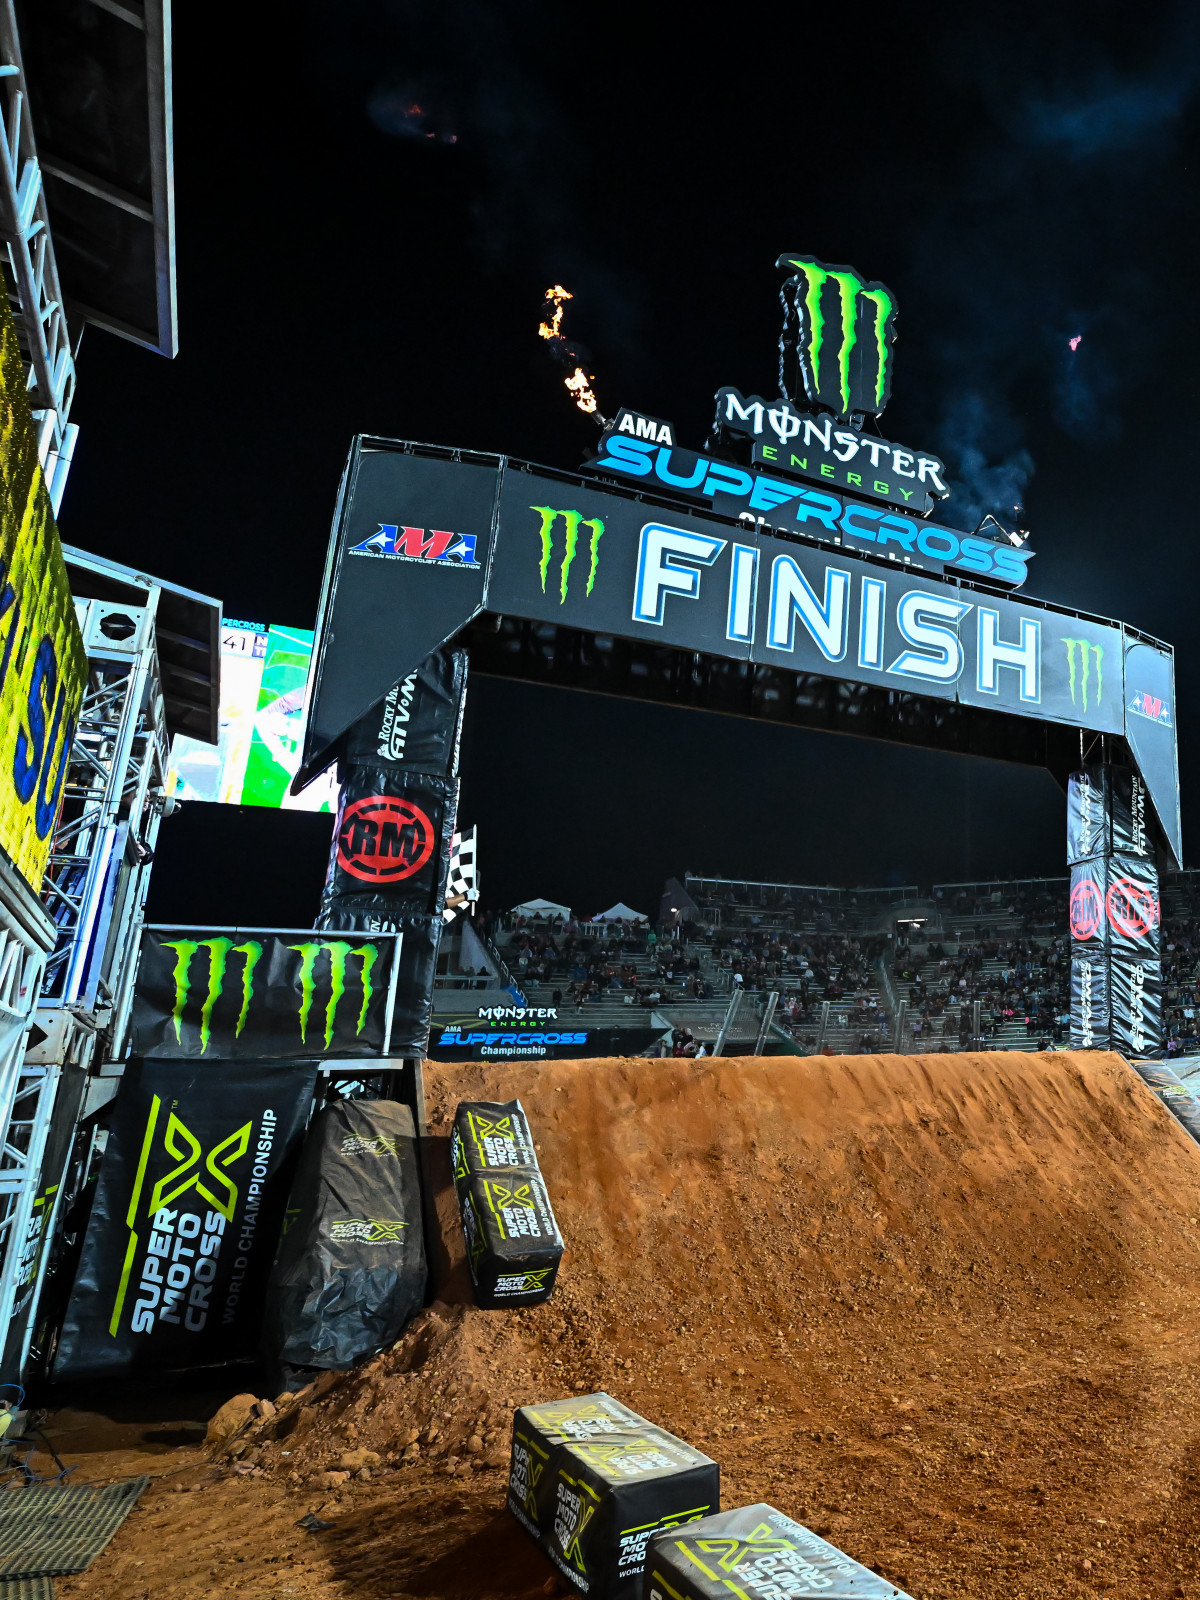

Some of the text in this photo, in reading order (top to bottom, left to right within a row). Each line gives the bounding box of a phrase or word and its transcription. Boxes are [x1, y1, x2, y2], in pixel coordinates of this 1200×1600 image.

[618, 413, 673, 446] AMA
[726, 393, 946, 490] MONSTER
[762, 446, 914, 500] ENERGY
[597, 435, 1036, 583] SUPERCROSS
[347, 523, 482, 565] AMA
[349, 550, 480, 570] AMERICAN MOTORCYCLIST ASSOCIATION
[222, 618, 265, 632] PERCROSS
[632, 522, 1041, 704] FINISH
[223, 635, 246, 651] 41
[350, 818, 417, 859] RM
[478, 1005, 558, 1020] MONSTER
[438, 1032, 588, 1045] SUPERCROSS
[481, 1046, 546, 1056] Championship
[221, 1108, 278, 1325] WORLD CHAMPIONSHIP
[502, 1207, 520, 1238] SUPER
[512, 1208, 531, 1236] MOTO
[523, 1206, 542, 1238] CROSS
[131, 1207, 179, 1335] SUPER
[159, 1212, 201, 1324] MOTO
[184, 1210, 226, 1332] CROSS
[496, 1275, 527, 1283] SUPER
[619, 1527, 664, 1548] SUP
[622, 1540, 648, 1556] MO
[618, 1551, 646, 1567] CRO
[773, 1549, 834, 1589] CROSS
[732, 1561, 792, 1600] SUPER
[754, 1556, 811, 1596] MOTO
